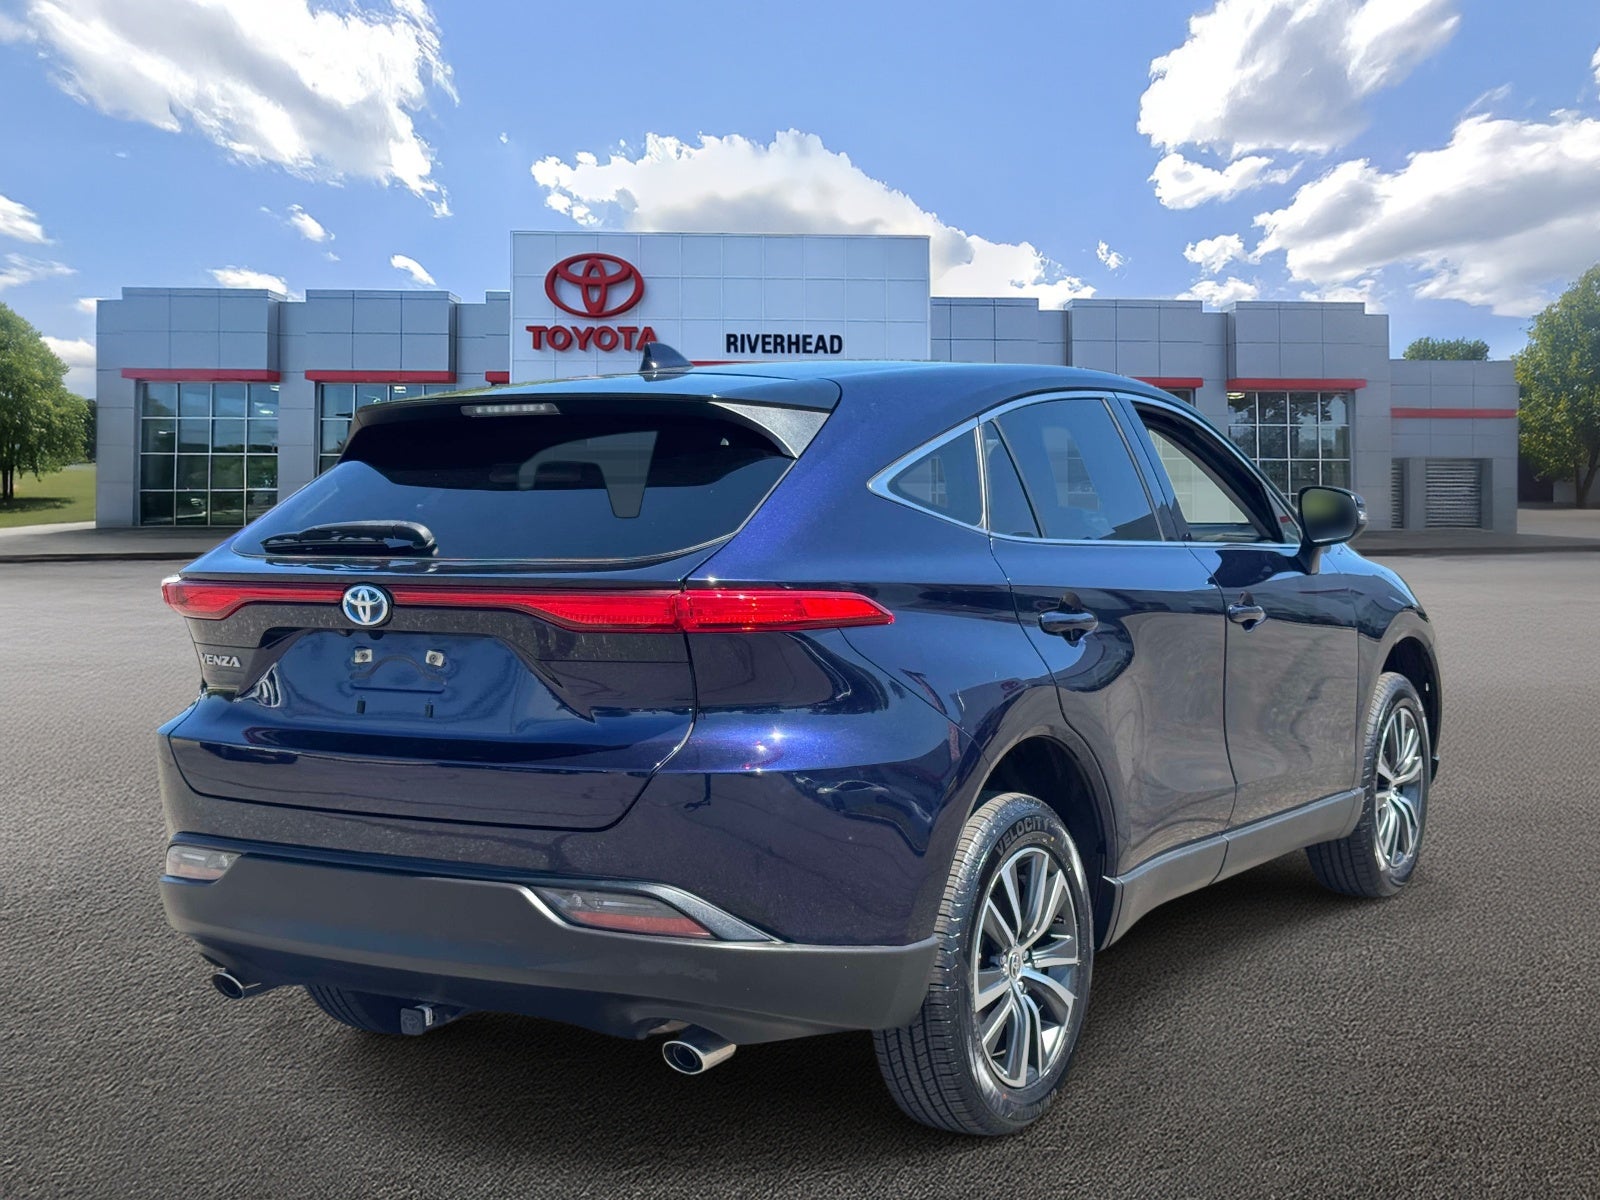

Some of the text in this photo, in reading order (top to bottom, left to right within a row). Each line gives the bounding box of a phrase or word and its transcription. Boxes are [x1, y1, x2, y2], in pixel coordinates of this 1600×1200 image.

[525, 325, 657, 352] TOYOTA
[726, 334, 843, 354] RIVERHEAD
[200, 653, 241, 668] VENZA
[994, 816, 1050, 856] VELOCITY
